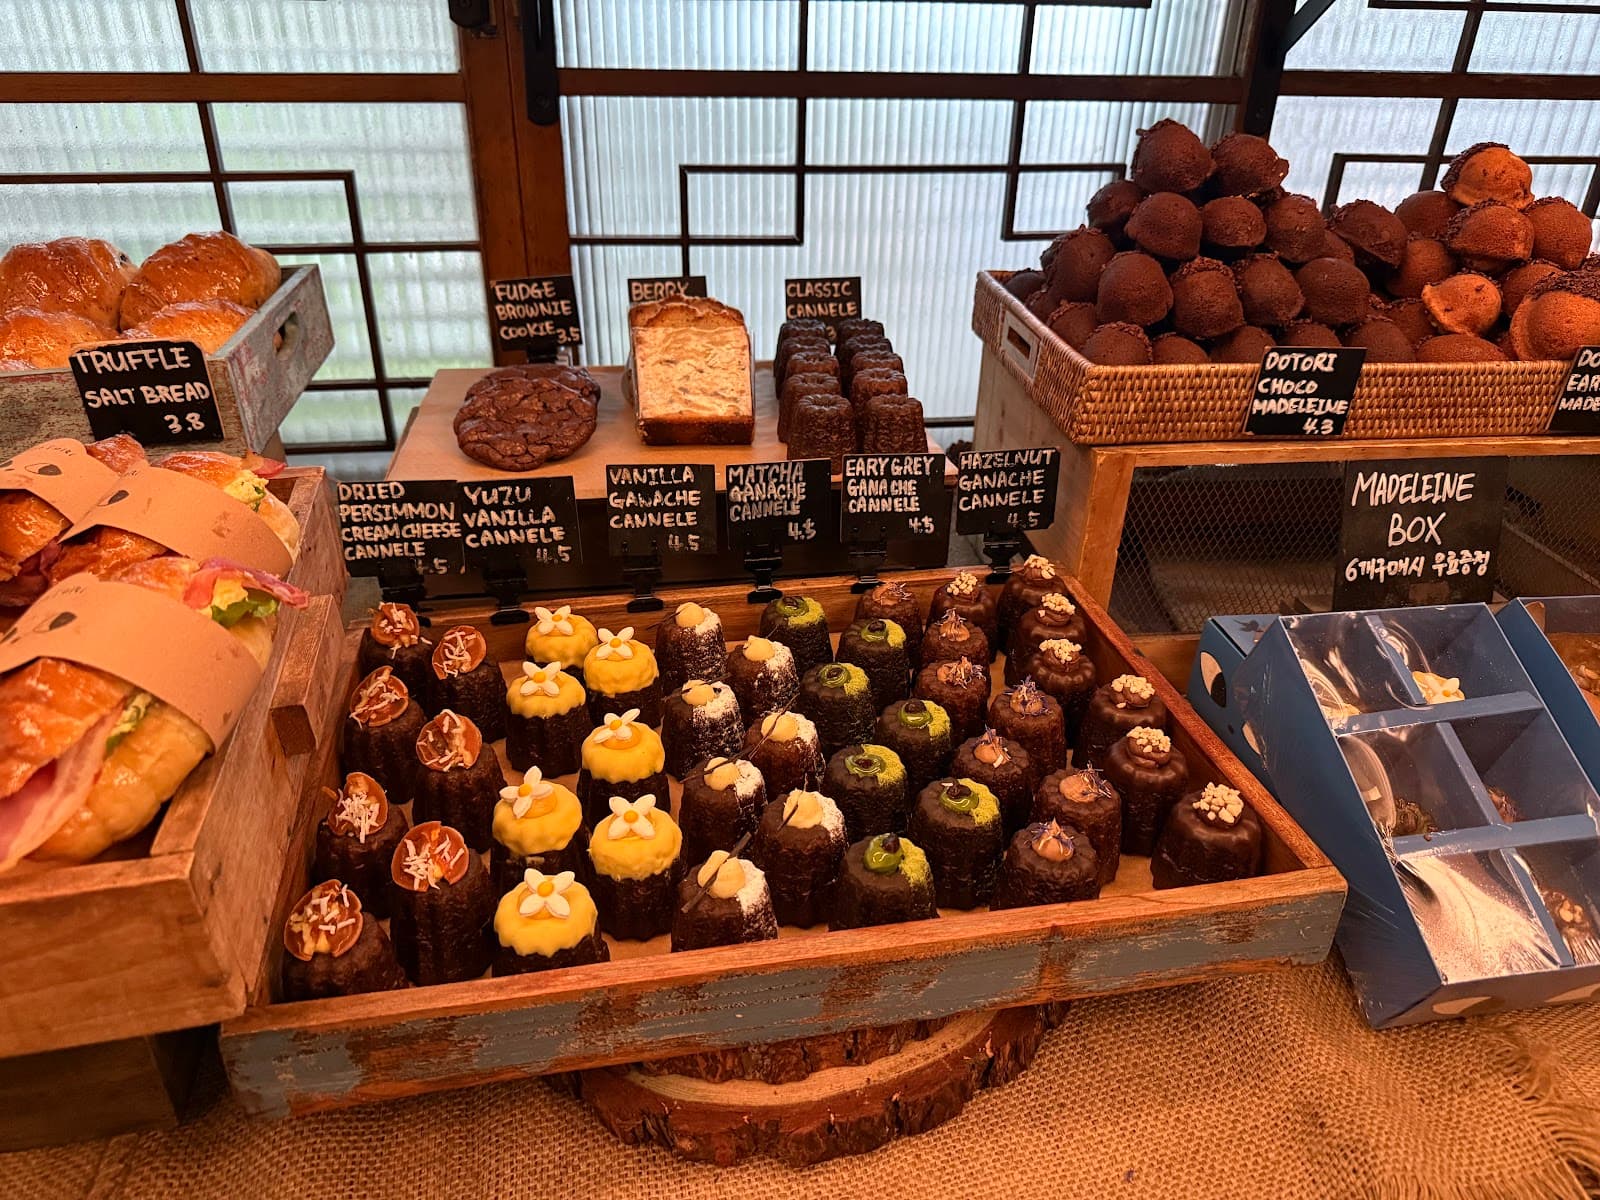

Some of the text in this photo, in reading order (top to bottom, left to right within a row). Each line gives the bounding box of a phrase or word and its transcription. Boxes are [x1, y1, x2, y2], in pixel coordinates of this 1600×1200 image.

[495, 281, 556, 301] FUDGE
[631, 281, 689, 301] BERRY
[786, 281, 852, 298] CLASSIC
[495, 300, 572, 320] BROWNIE
[786, 301, 857, 319] CANNELE
[500, 320, 580, 344] COOKIE 3.5
[72, 347, 191, 374] TRUFFLE
[1265, 351, 1338, 373] DOTORI
[84, 382, 210, 409] SALT BREAD
[1257, 377, 1319, 395] CHOCO
[1252, 397, 1349, 416] MADELEINE
[163, 412, 205, 434] 3.8
[1302, 417, 1334, 435] 4.3
[845, 456, 935, 477] EARY GREY
[960, 449, 1057, 470] HAZELNUT
[609, 466, 695, 486] VANILLA
[728, 462, 804, 485] MATCHA
[959, 469, 1045, 492] GANACHE
[338, 482, 405, 501] DRIED
[463, 485, 532, 505] YUZU
[608, 489, 701, 509] GANACHE
[729, 481, 806, 503] GANACHE
[1351, 471, 1476, 507] MADELEINE
[848, 497, 921, 513] CANNELE
[958, 489, 1046, 512] CANNELE
[339, 502, 455, 522] PERSIMMON
[463, 506, 556, 528] VANILLA
[609, 511, 698, 529] CANNELE
[729, 500, 801, 522] CANNELE
[1007, 510, 1041, 528] 4.5
[341, 522, 462, 542] CREAM CHEESE
[465, 526, 566, 548] CANNELE
[1388, 512, 1447, 547] BOX
[344, 542, 425, 561] CANNELE
[668, 534, 700, 551] 4.5
[536, 545, 572, 563] 4.5
